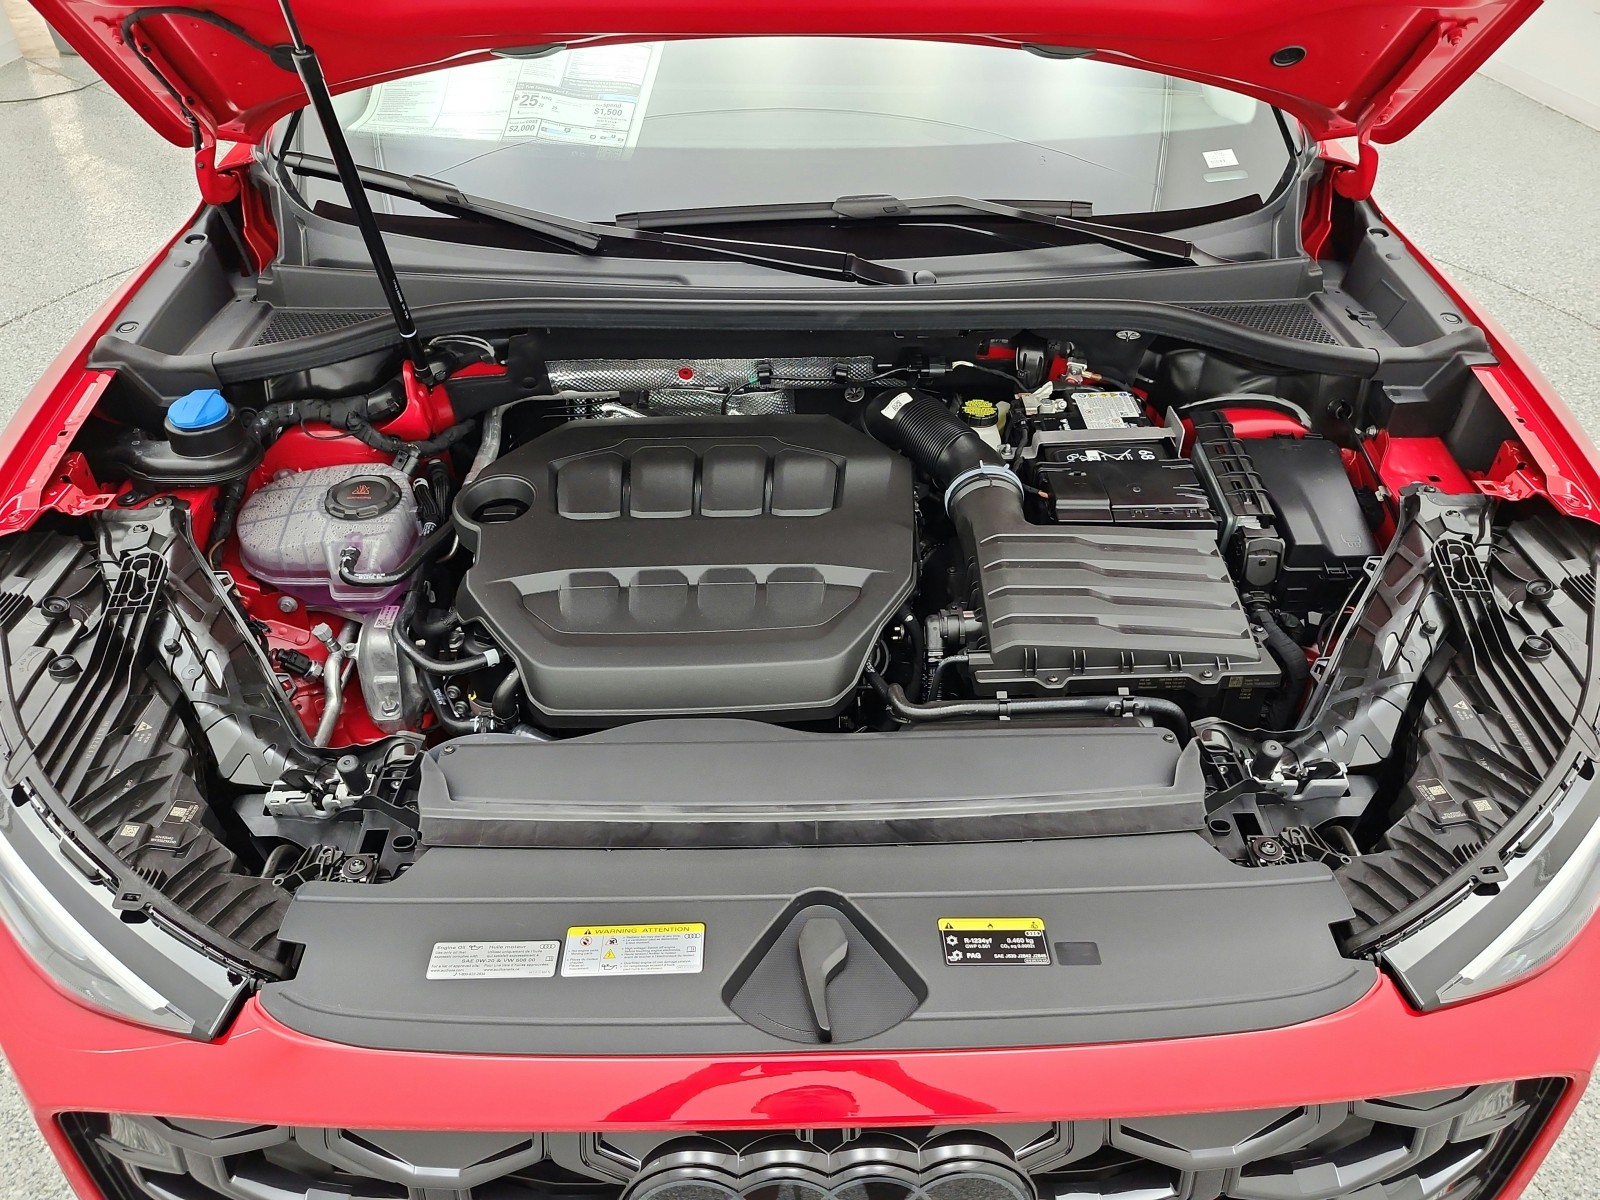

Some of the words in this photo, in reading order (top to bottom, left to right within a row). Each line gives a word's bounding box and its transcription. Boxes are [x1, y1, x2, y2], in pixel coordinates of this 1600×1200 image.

[519, 94, 540, 106] 25
[593, 107, 623, 116] $1,500
[508, 124, 535, 132] $2,000
